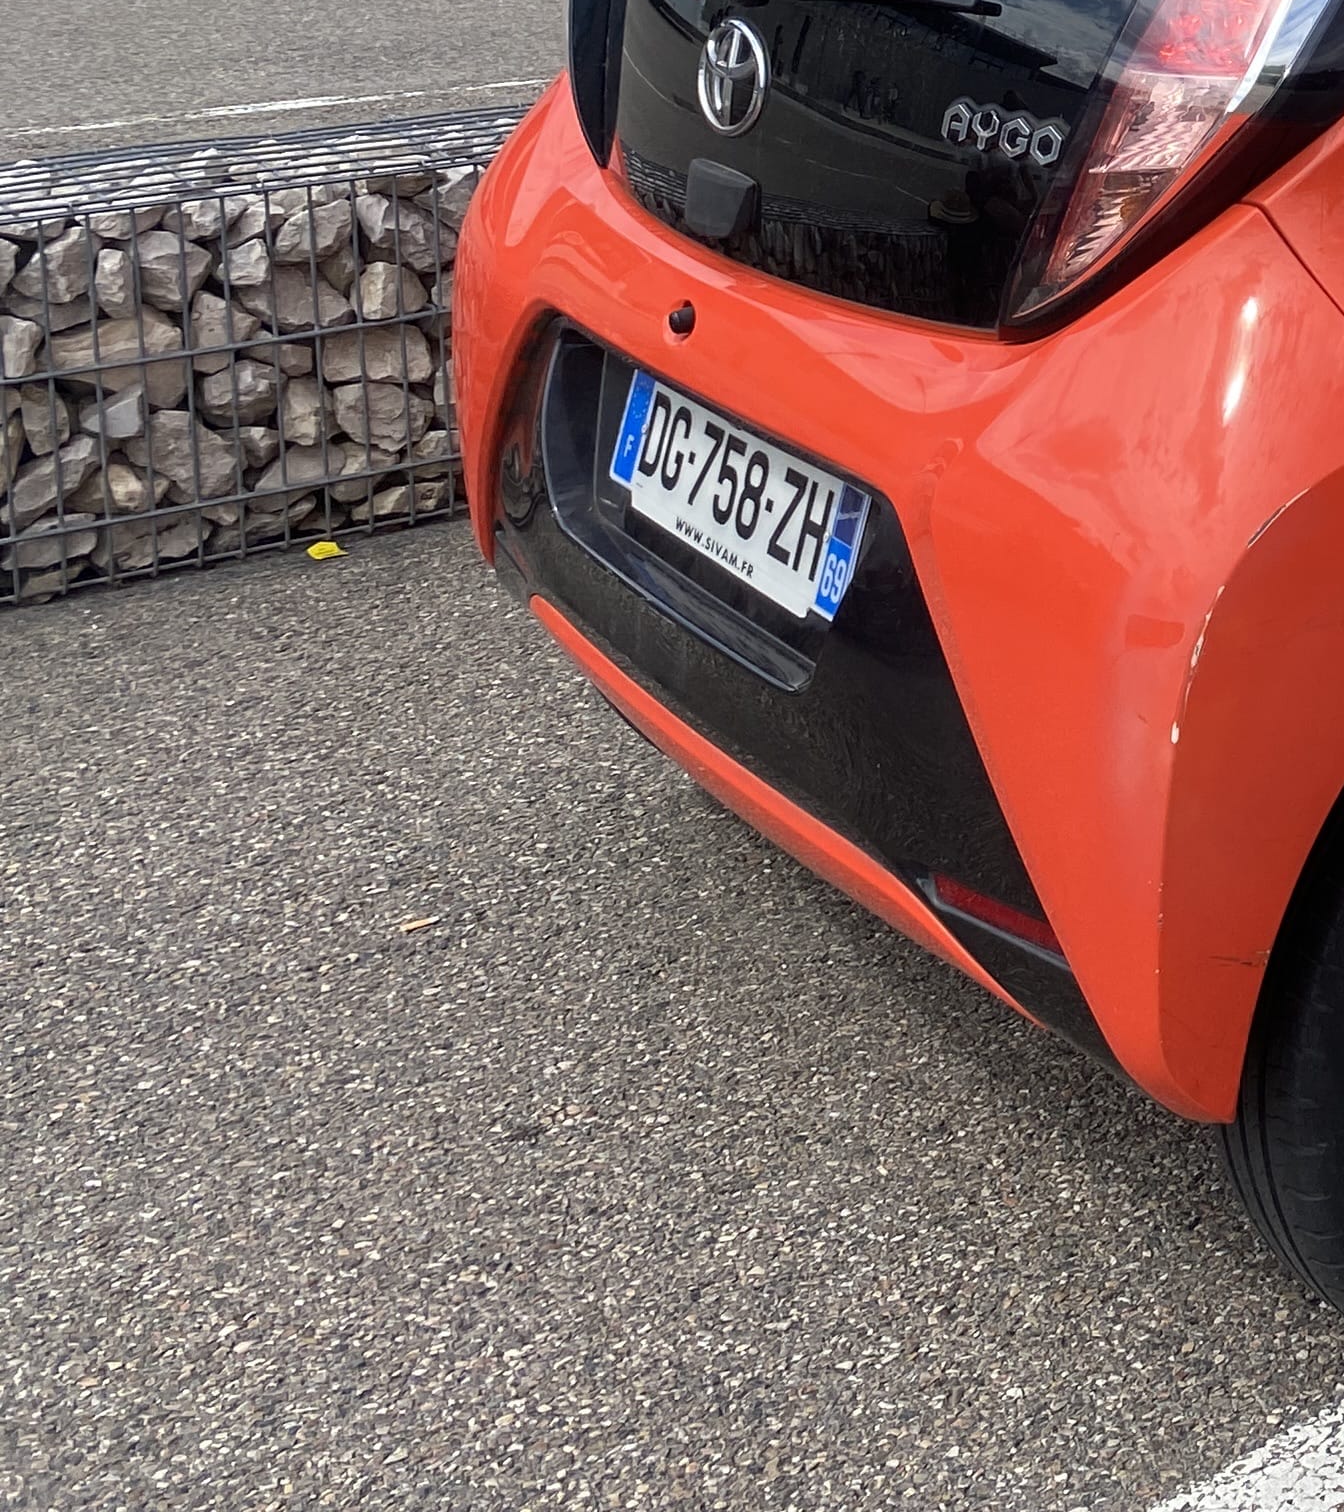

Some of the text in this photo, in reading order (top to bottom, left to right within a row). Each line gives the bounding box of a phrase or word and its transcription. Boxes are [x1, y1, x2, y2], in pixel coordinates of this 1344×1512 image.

[941, 103, 1063, 166] AYGO
[623, 434, 635, 458] F
[638, 390, 835, 582] DG-758-ZH
[675, 516, 754, 579] WWW.SIVAM.FR
[820, 552, 847, 604] 69
